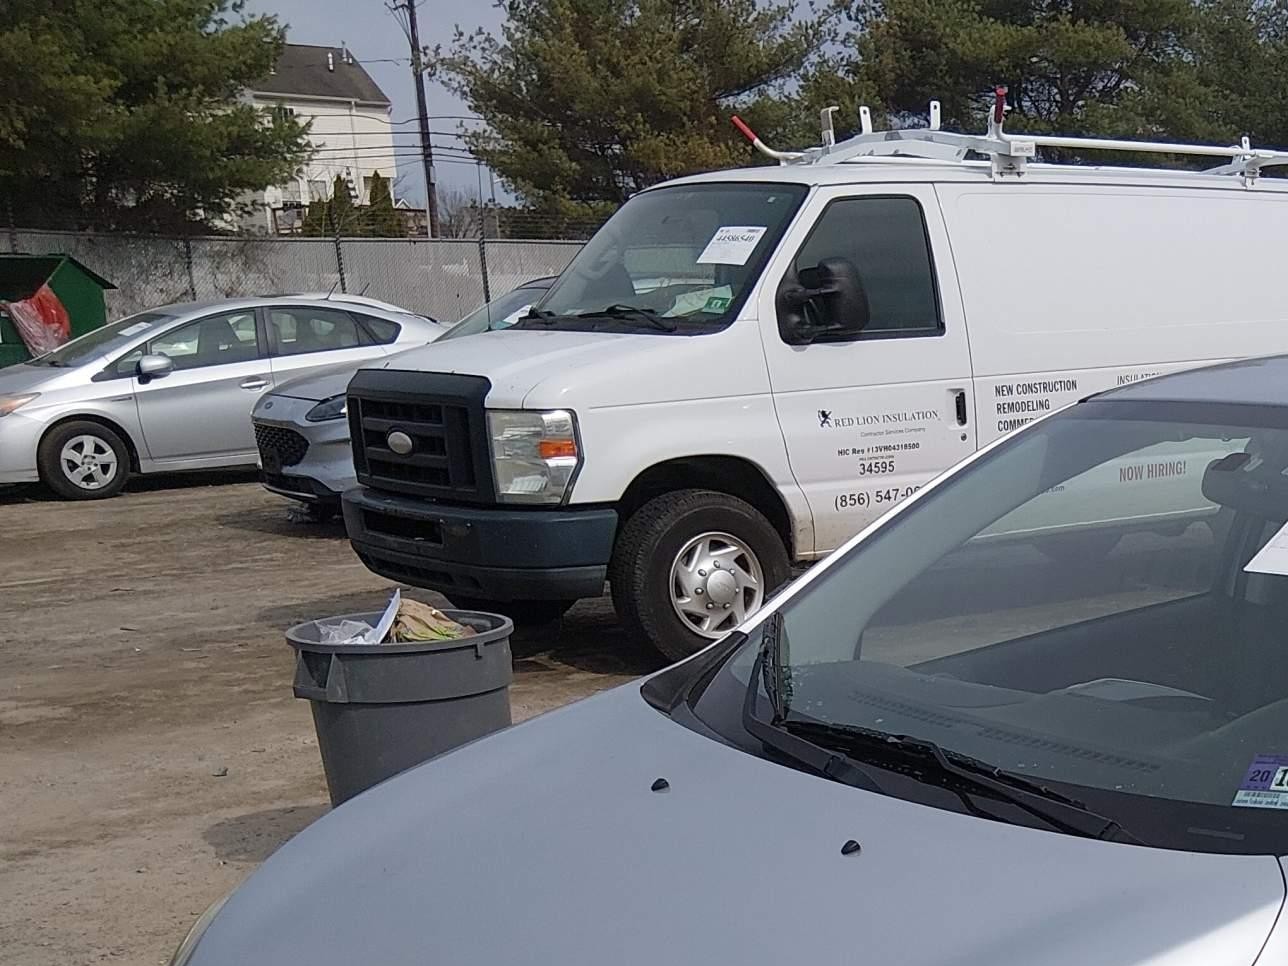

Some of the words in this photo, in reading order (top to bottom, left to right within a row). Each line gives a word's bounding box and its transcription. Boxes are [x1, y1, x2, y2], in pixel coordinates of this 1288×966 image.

[994, 383, 1014, 397] NEW
[1016, 379, 1078, 395] CONSTRUCTION
[996, 399, 1050, 414] REMODELING
[833, 418, 855, 428] RED
[857, 414, 880, 426] LION
[881, 410, 939, 423] INSULATION
[859, 461, 895, 475] 34595
[1119, 464, 1144, 482] NOW
[1146, 460, 1186, 479] HIRING!
[834, 491, 870, 511] (856)
[1249, 769, 1271, 782] 20
